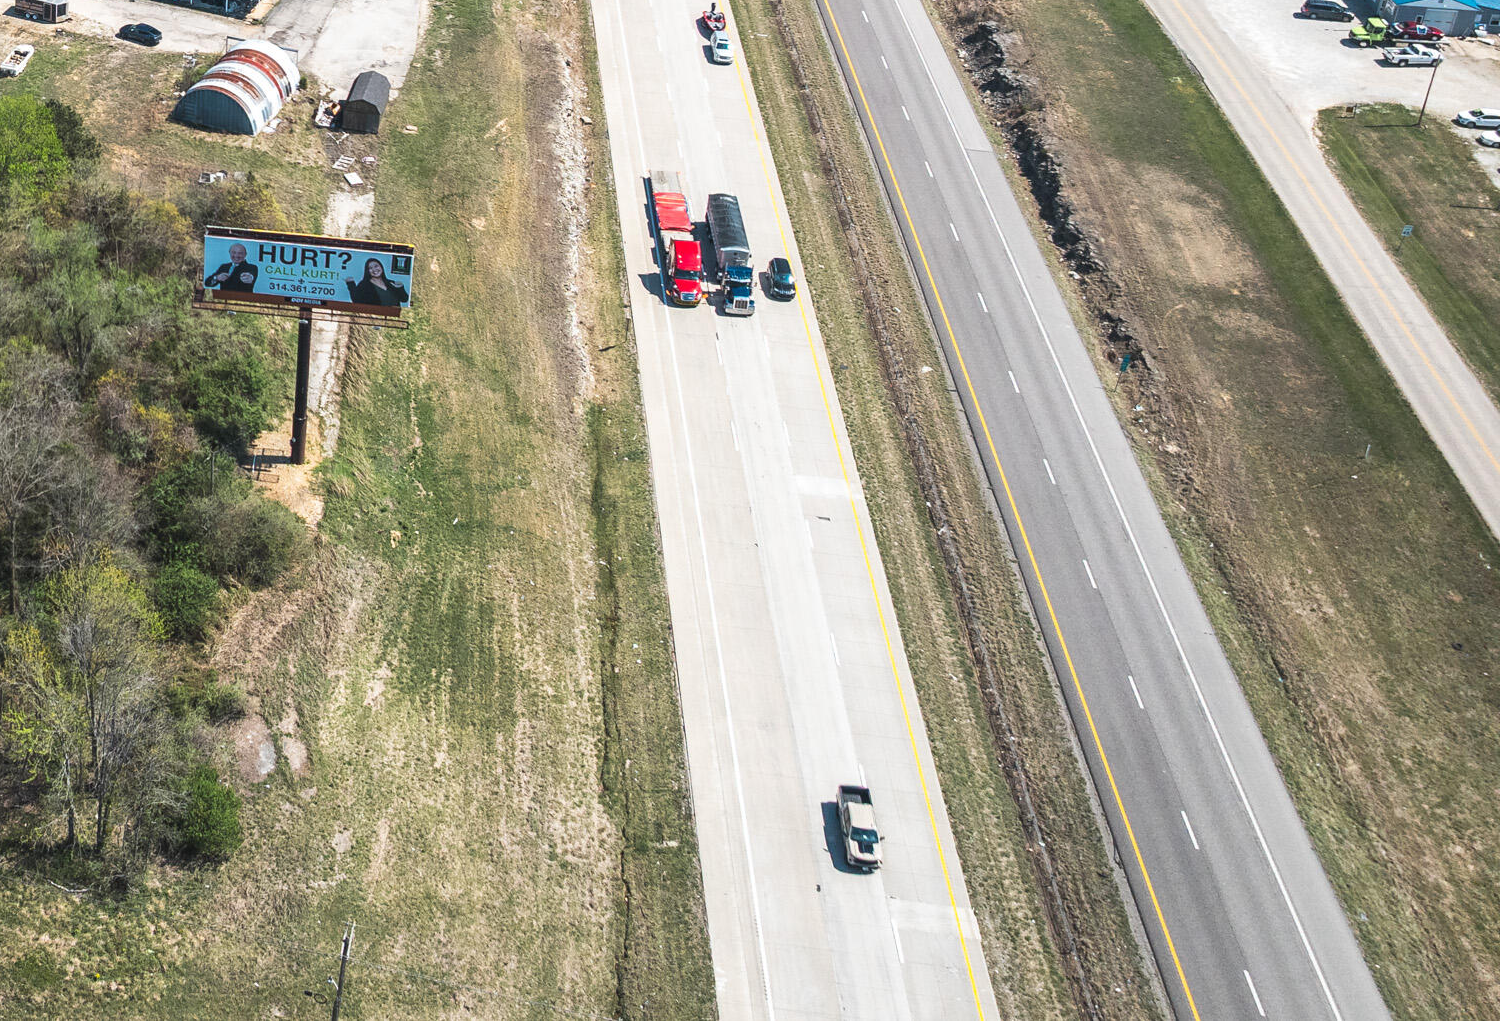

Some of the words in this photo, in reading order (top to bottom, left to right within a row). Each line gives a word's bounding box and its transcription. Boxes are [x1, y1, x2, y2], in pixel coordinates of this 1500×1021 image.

[258, 244, 352, 270] HURT?
[265, 265, 297, 276] CALL
[301, 268, 340, 280] KURT!
[269, 282, 336, 295] 314.361.2700
